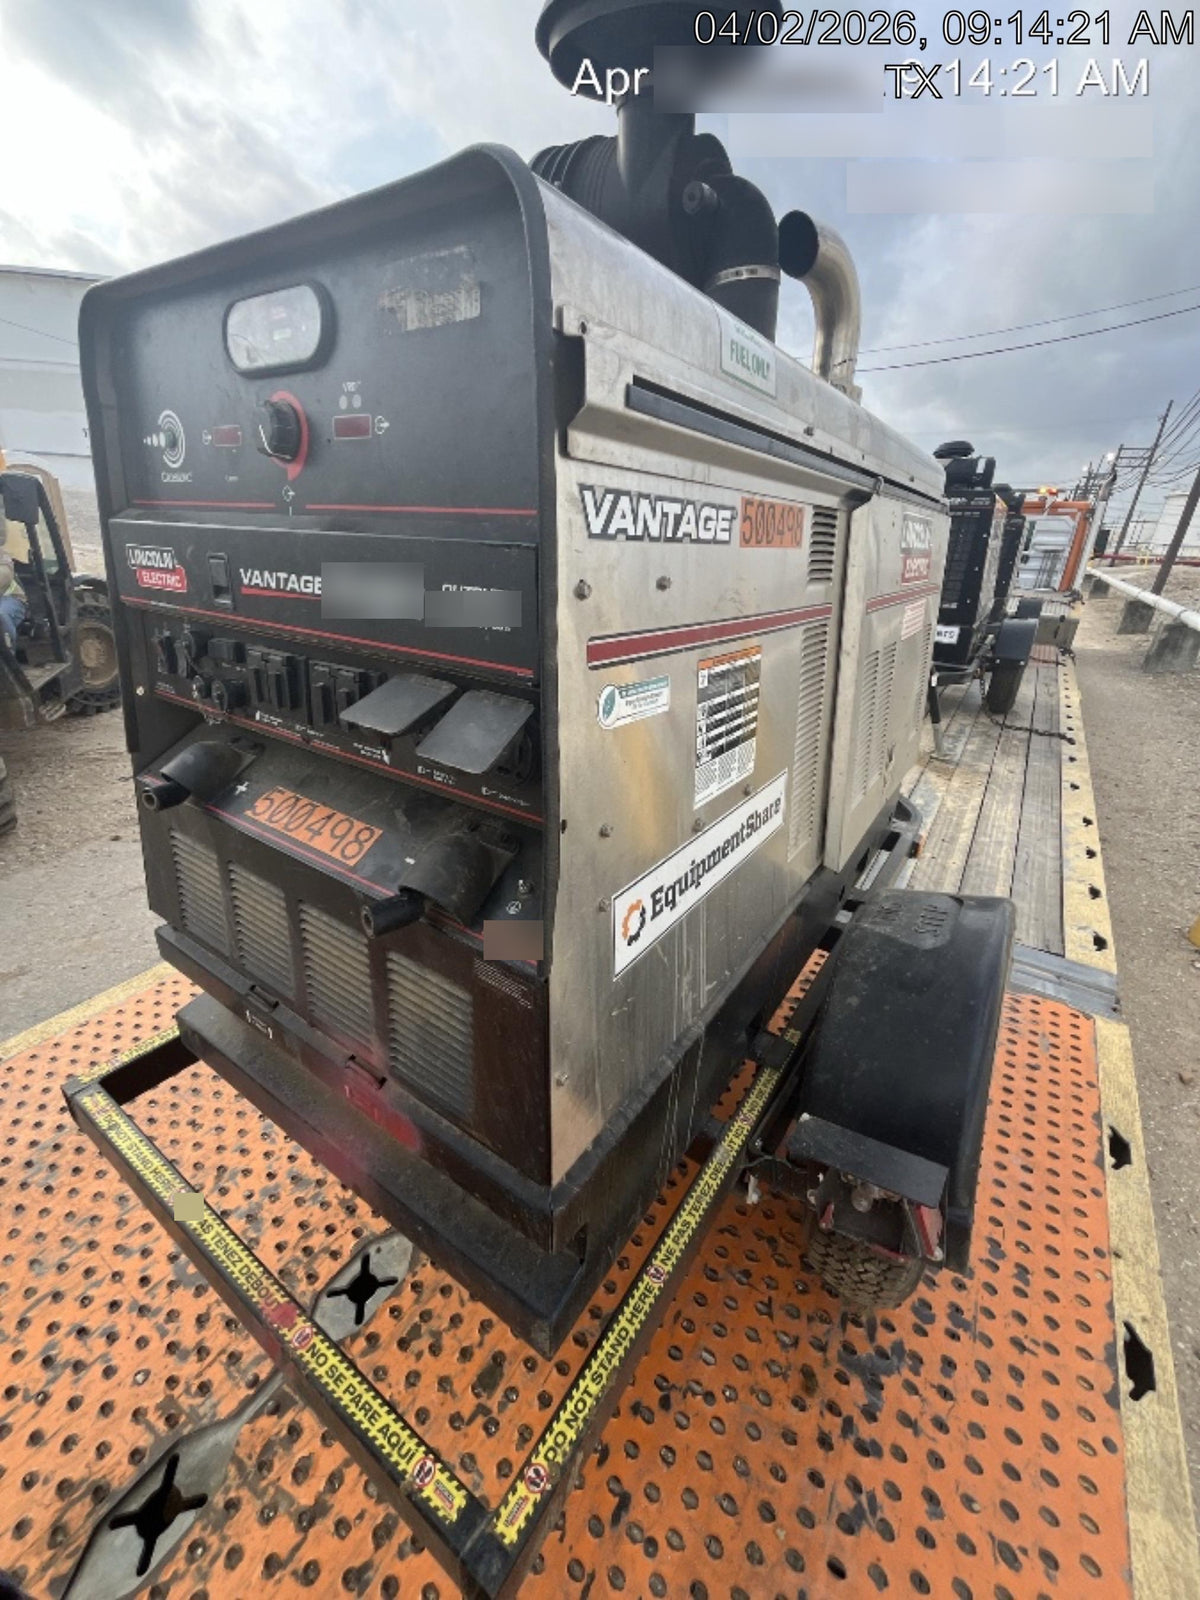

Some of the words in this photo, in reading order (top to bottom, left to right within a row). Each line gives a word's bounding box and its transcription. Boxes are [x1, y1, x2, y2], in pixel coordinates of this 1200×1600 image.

[581, 487, 735, 544] VANTAGE
[742, 500, 802, 549] 500498
[128, 548, 174, 569] LINCOLN
[141, 570, 182, 589] ELECTRIC
[250, 788, 377, 862] 500498
[650, 797, 782, 922] EquipmentShare
[211, 1229, 244, 1269] TENEZ
[661, 1245, 676, 1266] NE
[672, 1220, 691, 1244] PAS
[306, 1343, 328, 1367] NO
[325, 1364, 346, 1388] SE
[343, 1382, 382, 1427] PARE
[544, 1430, 567, 1462] DO
[565, 1387, 595, 1431] NOT
[592, 1325, 631, 1386] STAND
[627, 1284, 656, 1322] HERE
